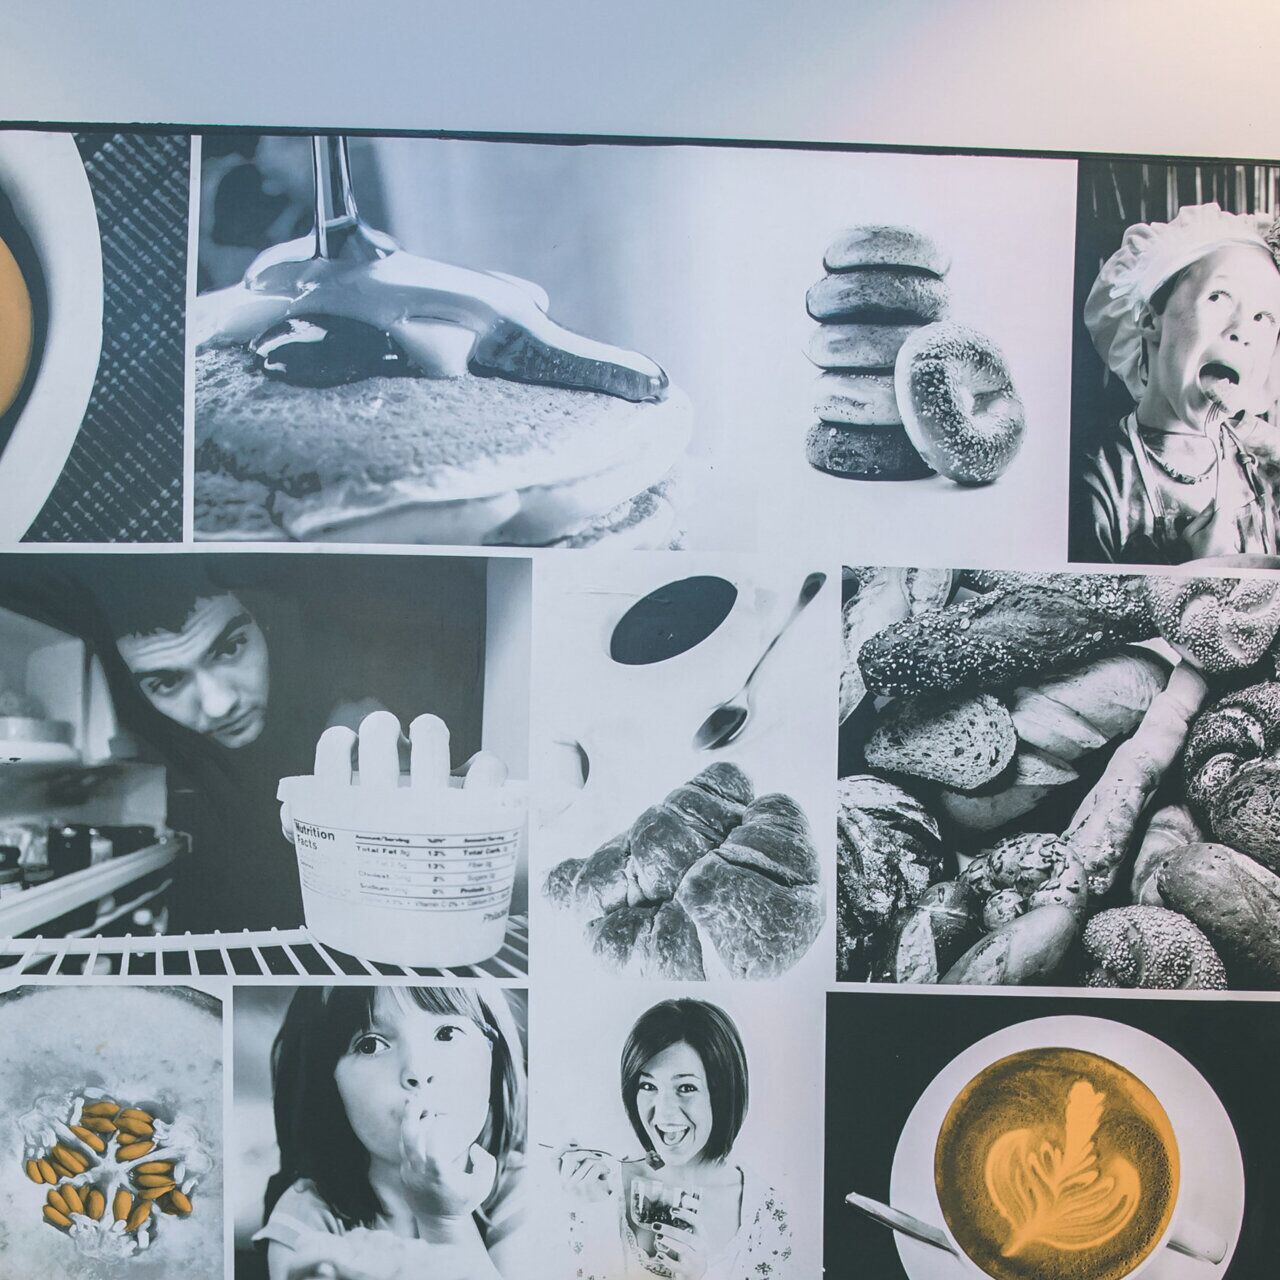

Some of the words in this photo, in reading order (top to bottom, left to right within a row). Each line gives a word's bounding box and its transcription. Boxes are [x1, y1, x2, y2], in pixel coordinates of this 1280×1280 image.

[294, 821, 335, 841] Nutrition
[297, 833, 318, 850] Facts
[356, 845, 379, 854] Total
[382, 847, 398, 855] Fat
